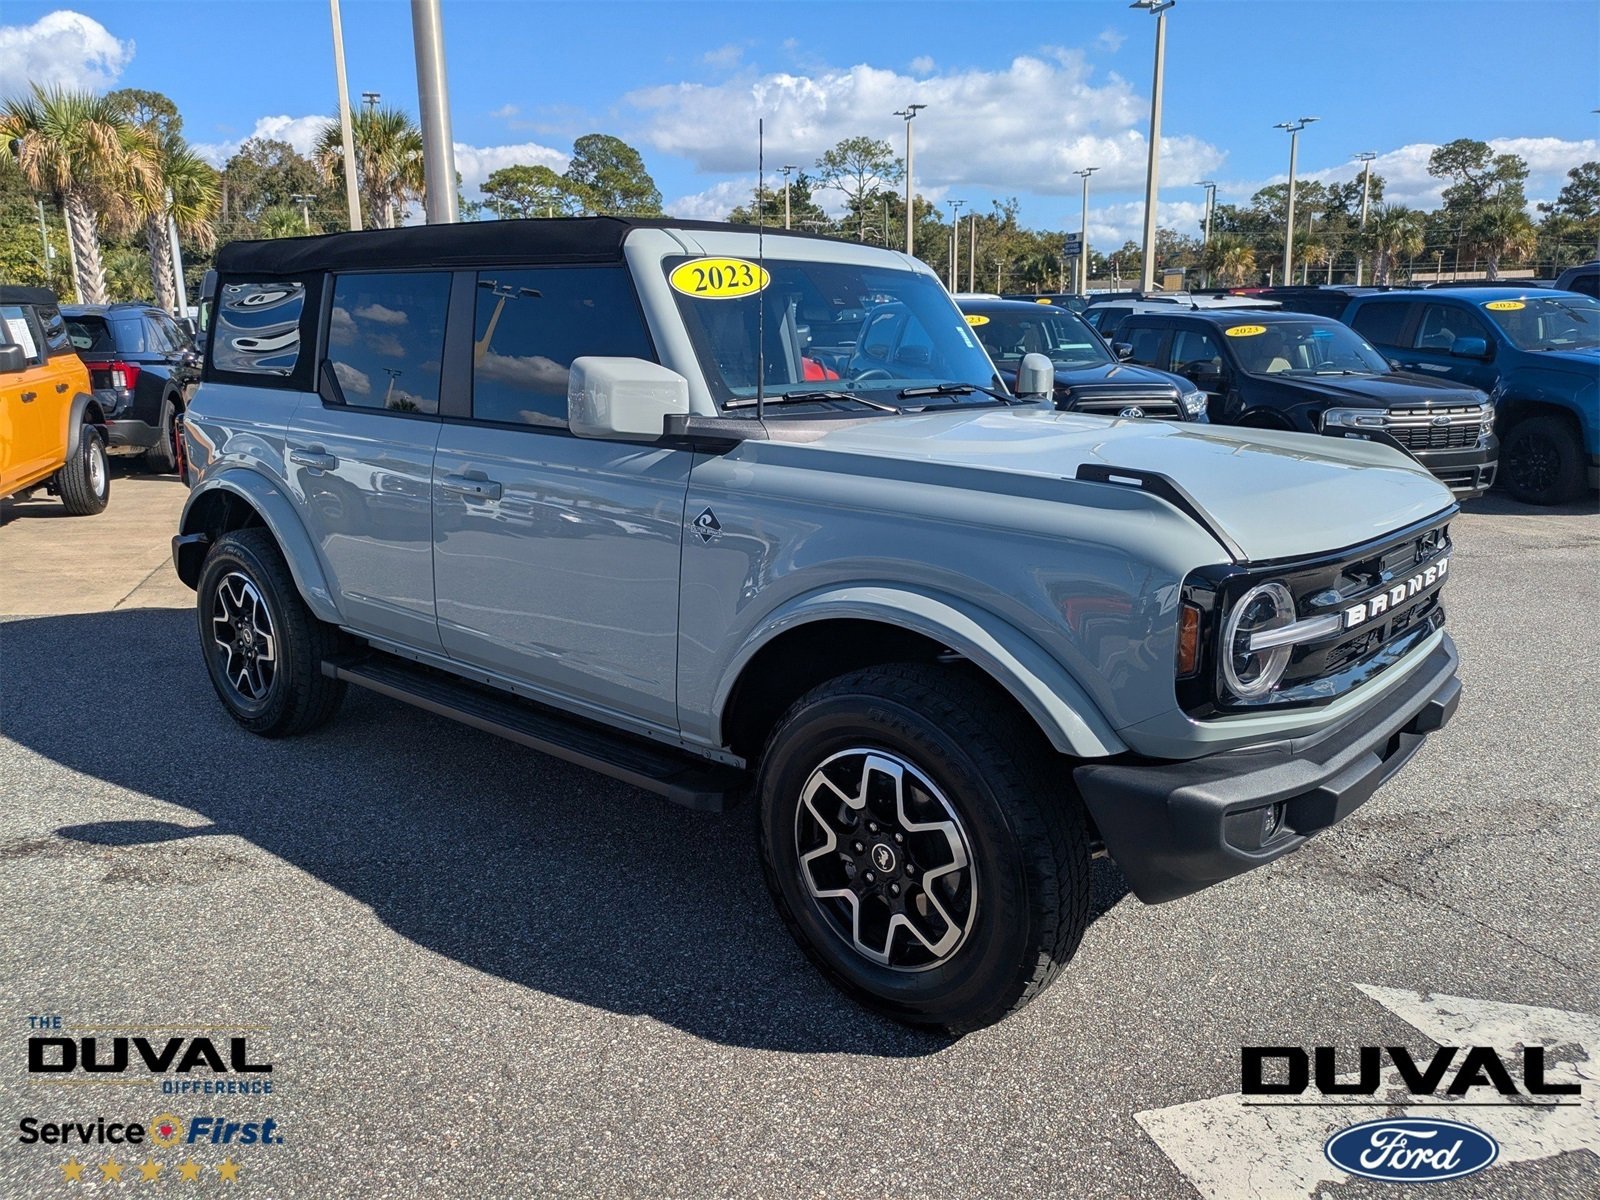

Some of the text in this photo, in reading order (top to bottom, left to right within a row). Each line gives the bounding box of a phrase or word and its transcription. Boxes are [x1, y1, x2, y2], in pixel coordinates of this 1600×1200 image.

[692, 264, 754, 292] 2023
[1233, 327, 1259, 335] 2023
[1345, 557, 1449, 628] BRONCO
